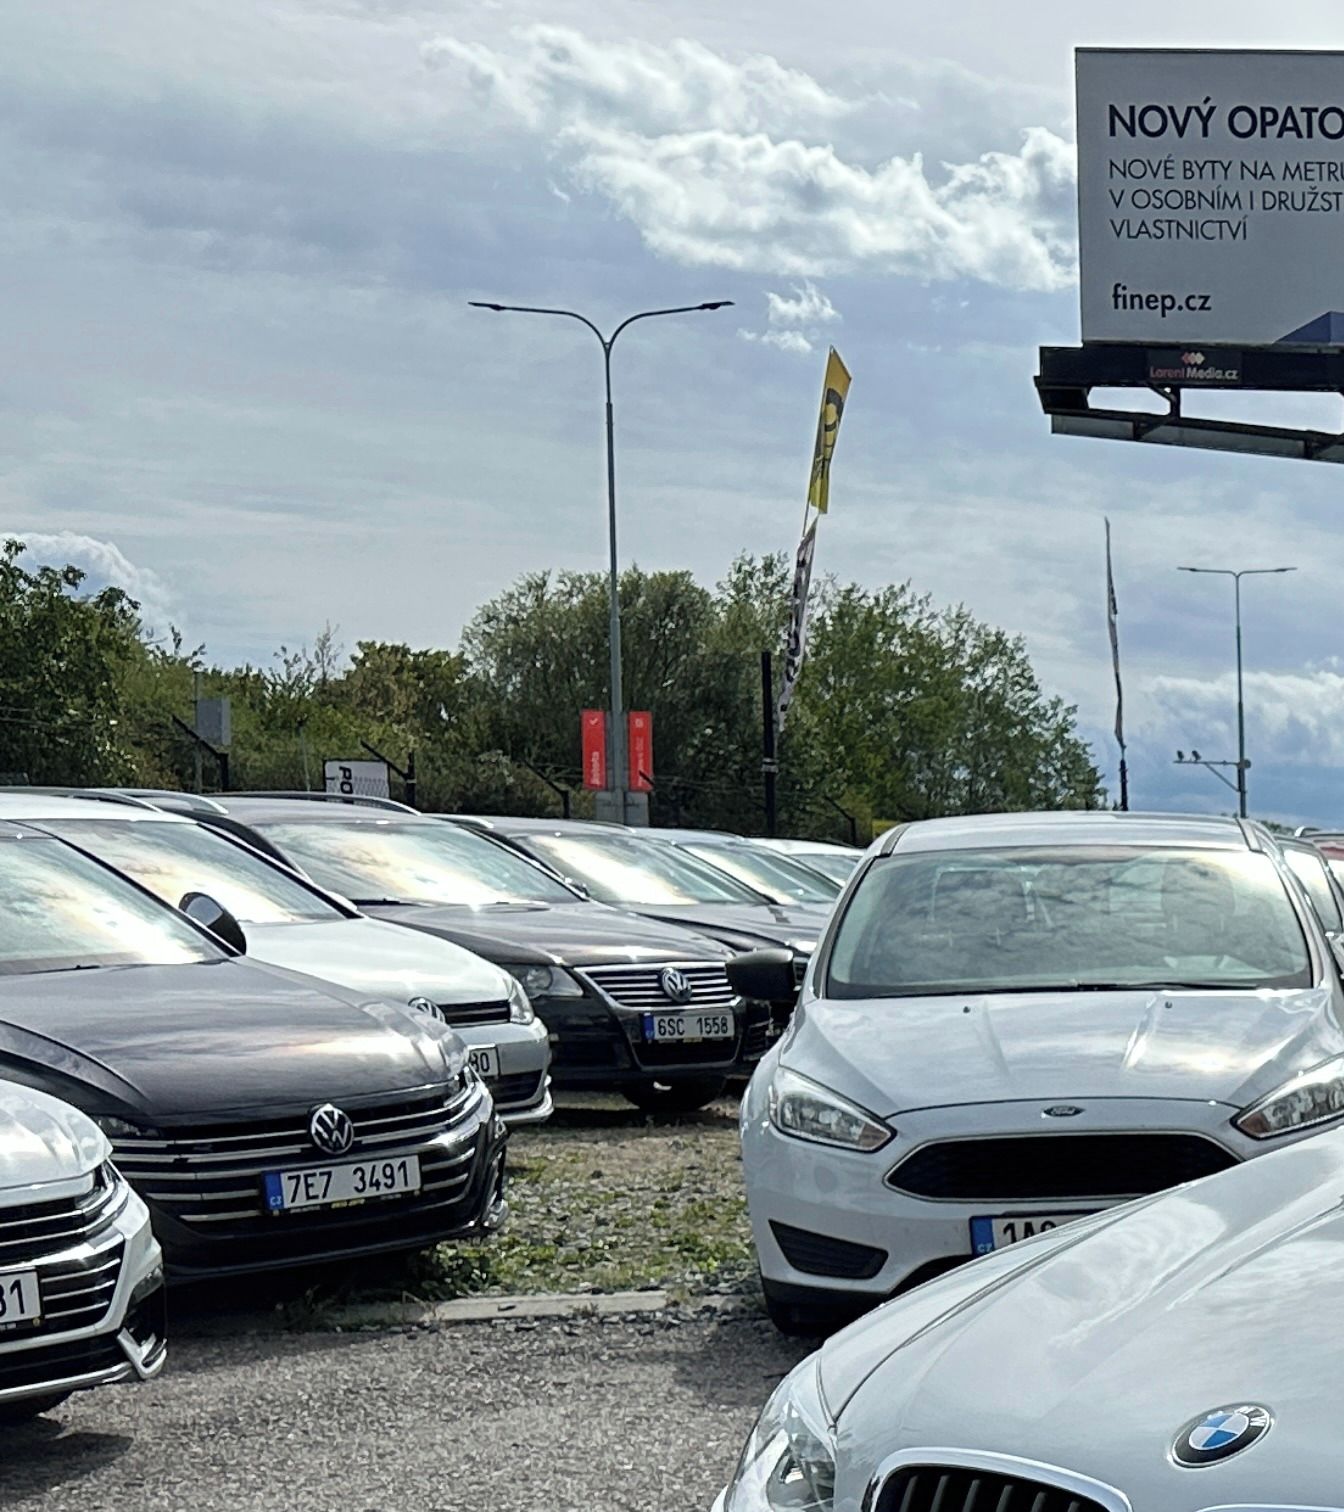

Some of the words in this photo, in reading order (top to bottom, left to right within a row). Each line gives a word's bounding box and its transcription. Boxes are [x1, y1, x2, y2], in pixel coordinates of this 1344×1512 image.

[1108, 95, 1218, 138] NOVÝ
[1109, 154, 1175, 180] NOVÉ
[1183, 160, 1233, 181] BYTY
[1240, 160, 1276, 181] NA
[1108, 188, 1125, 209] V
[1131, 184, 1243, 210] OSOBNÍM
[1109, 215, 1249, 240] VLASTNICTVÍ
[1111, 282, 1212, 318] finep.cz
[657, 1018, 686, 1037] 6SC
[696, 1015, 728, 1035] 1558
[287, 1170, 333, 1204] 7E7
[352, 1160, 409, 1194] 3491
